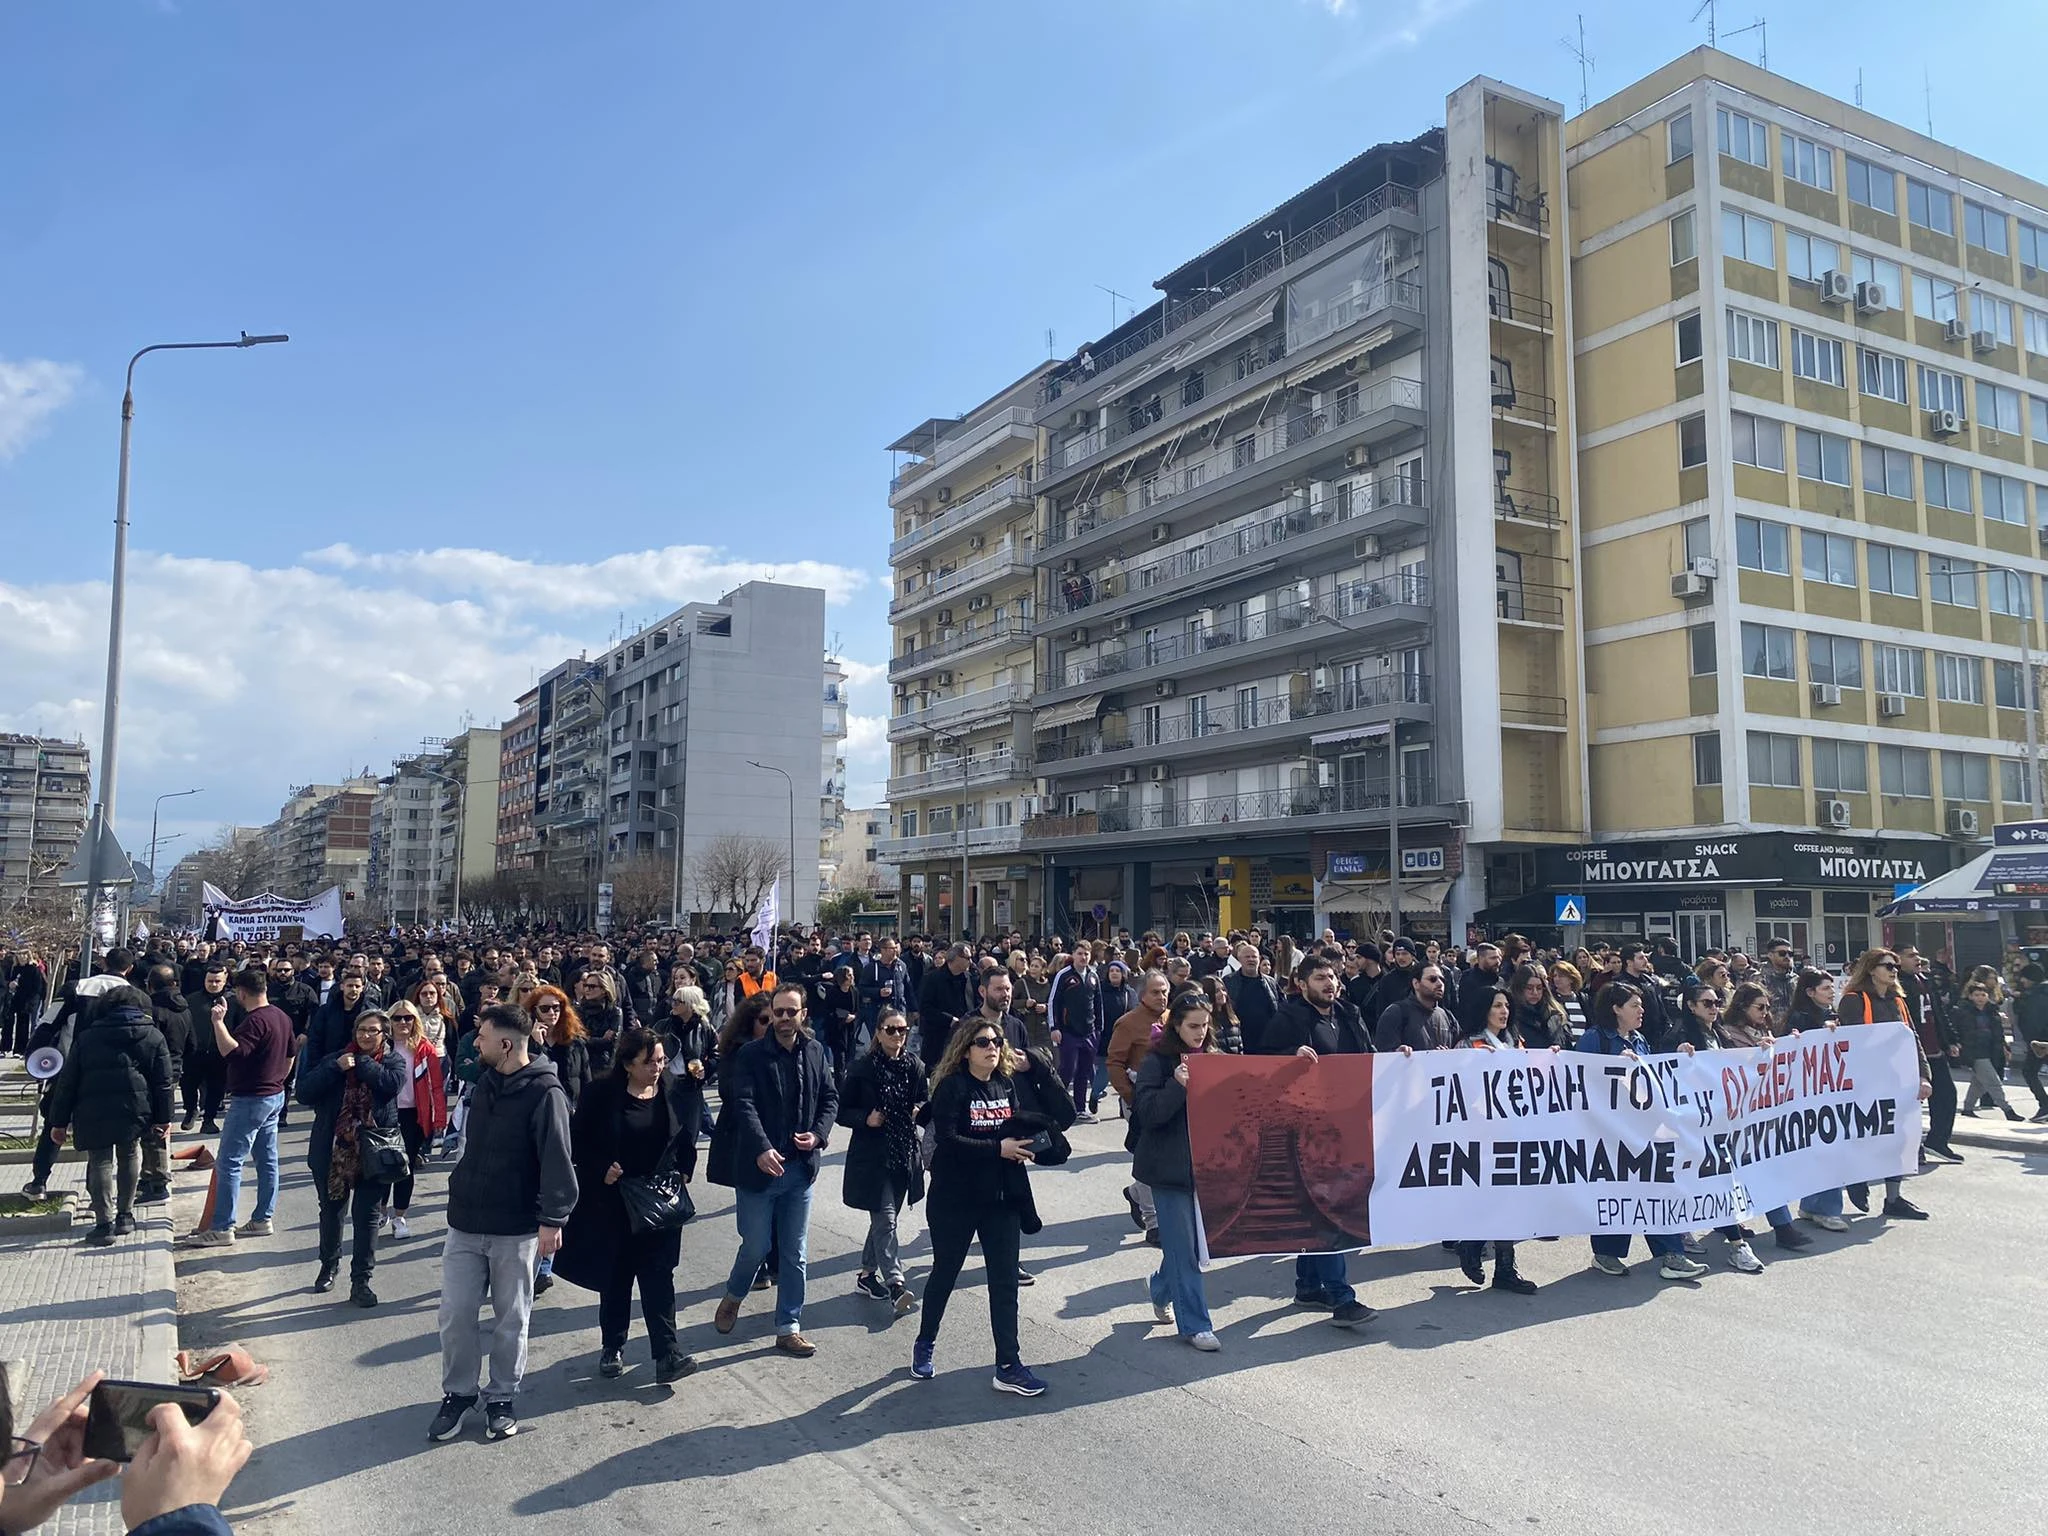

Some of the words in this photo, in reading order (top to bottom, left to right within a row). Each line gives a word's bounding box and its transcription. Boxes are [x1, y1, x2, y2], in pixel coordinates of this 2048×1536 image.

[1566, 850, 1608, 862] COFFEE
[1695, 843, 1738, 856] SNACK
[1793, 843, 1819, 853] COFFEE
[1820, 845, 1834, 854] AND
[1835, 846, 1854, 855] MORE
[1585, 858, 1720, 881] ΜΠΟΥΓΑΤΣΑ
[1820, 857, 1926, 880] ΜΠΟΥΓΑΤΣΑ
[229, 915, 255, 924] ΚΑΜΙΑ
[1431, 1073, 1468, 1126] ΤΑ
[1604, 1058, 1688, 1111] ΤΟΥΣ
[1722, 1065, 1749, 1121] ΟΙ
[1802, 1040, 1853, 1098] ΜΑΣ
[1399, 1141, 1480, 1188] ΔΕΝ
[1491, 1138, 1676, 1186] ΞΕΧΝΑΜΕ
[1598, 1197, 1689, 1227] ΕΡΓΑΤΙΚΑ
[1692, 1184, 1755, 1222] ΣΩΜΑΕΙΑ
